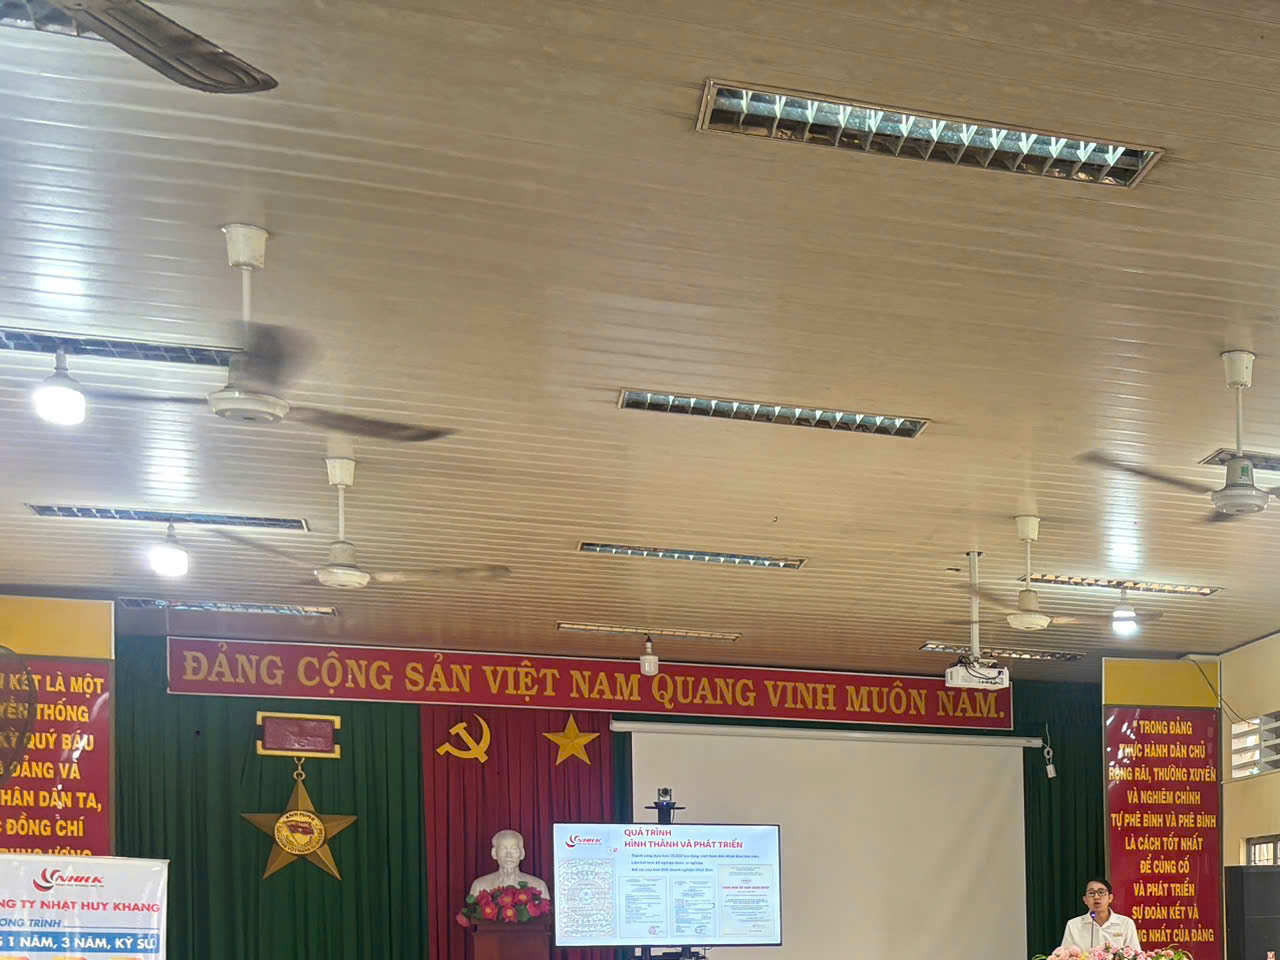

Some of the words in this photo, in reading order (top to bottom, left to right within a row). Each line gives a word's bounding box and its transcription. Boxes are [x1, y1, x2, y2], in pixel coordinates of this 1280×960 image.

[46, 671, 65, 693] LÀ
[70, 673, 104, 698] MỘT
[182, 642, 284, 686] ĐẢNG
[297, 650, 393, 695] CỘNG
[405, 653, 472, 693] SẢN
[482, 659, 560, 703] VIỆT
[570, 670, 641, 701] NAM
[651, 673, 756, 709] QUANG
[764, 679, 837, 711] VINH
[845, 680, 927, 715] MUÔN
[36, 698, 89, 722] THỐNG
[1140, 720, 1168, 734] TRONG
[1170, 716, 1192, 735] ĐẢNG
[62, 730, 94, 751] BÁU
[1144, 741, 1168, 757] HÀNH
[1170, 742, 1187, 758] DÂN
[1189, 740, 1206, 758] CHỦ
[59, 758, 80, 780] VÀ
[1108, 764, 1133, 783] RỘNG
[1153, 764, 1187, 781] THƯỜNG
[1189, 766, 1216, 782] XUYÊN
[39, 787, 72, 808] DÂN
[76, 792, 102, 813] TA,
[1127, 787, 1139, 803] VÀ
[1140, 788, 1174, 804] NGHIÊM
[1175, 786, 1201, 804] CHỈNH
[6, 812, 51, 836] ĐỒNG
[56, 815, 85, 837] CHÍ
[1111, 811, 1123, 830] TỰ
[1124, 811, 1141, 827] PHÊ
[1143, 811, 1163, 827] BÌNH
[1165, 811, 1177, 827] VÀ
[1178, 812, 1195, 827] PHÊ
[1197, 811, 1216, 828] BÌNH
[624, 826, 643, 837] QUÁ
[645, 826, 672, 836] TRÌNH
[624, 838, 647, 849] HÌNH
[648, 838, 680, 849] THÀNH
[680, 838, 692, 849] VÀ
[694, 839, 717, 849] PHÁT
[1125, 833, 1136, 850] LÀ
[1138, 834, 1161, 850] CÁCH
[1163, 832, 1179, 850] TỐT
[1181, 832, 1203, 851] NHẤT
[1140, 853, 1152, 874] ĐỂ
[1153, 855, 1177, 874] CỦNG
[1178, 854, 1190, 873] CỐ
[1133, 880, 1145, 897] VÀ
[1146, 880, 1169, 897] PHÁT
[1170, 877, 1195, 897] TRIỂN
[20, 899, 36, 909] TY
[81, 901, 109, 911] HUY
[113, 902, 160, 912] KHANG
[1132, 903, 1143, 923] SỰ
[1144, 903, 1168, 919] ĐOÀN
[1169, 901, 1186, 919] KẾT
[1187, 903, 1199, 920] VÀ
[8, 936, 14, 947] 1
[20, 934, 58, 949] NĂM,
[61, 937, 70, 948] 3
[74, 935, 112, 950] NĂM,
[1149, 923, 1171, 942] NHẤT
[1173, 923, 1190, 942] CỦA
[1191, 923, 1214, 942] ĐẢNG
